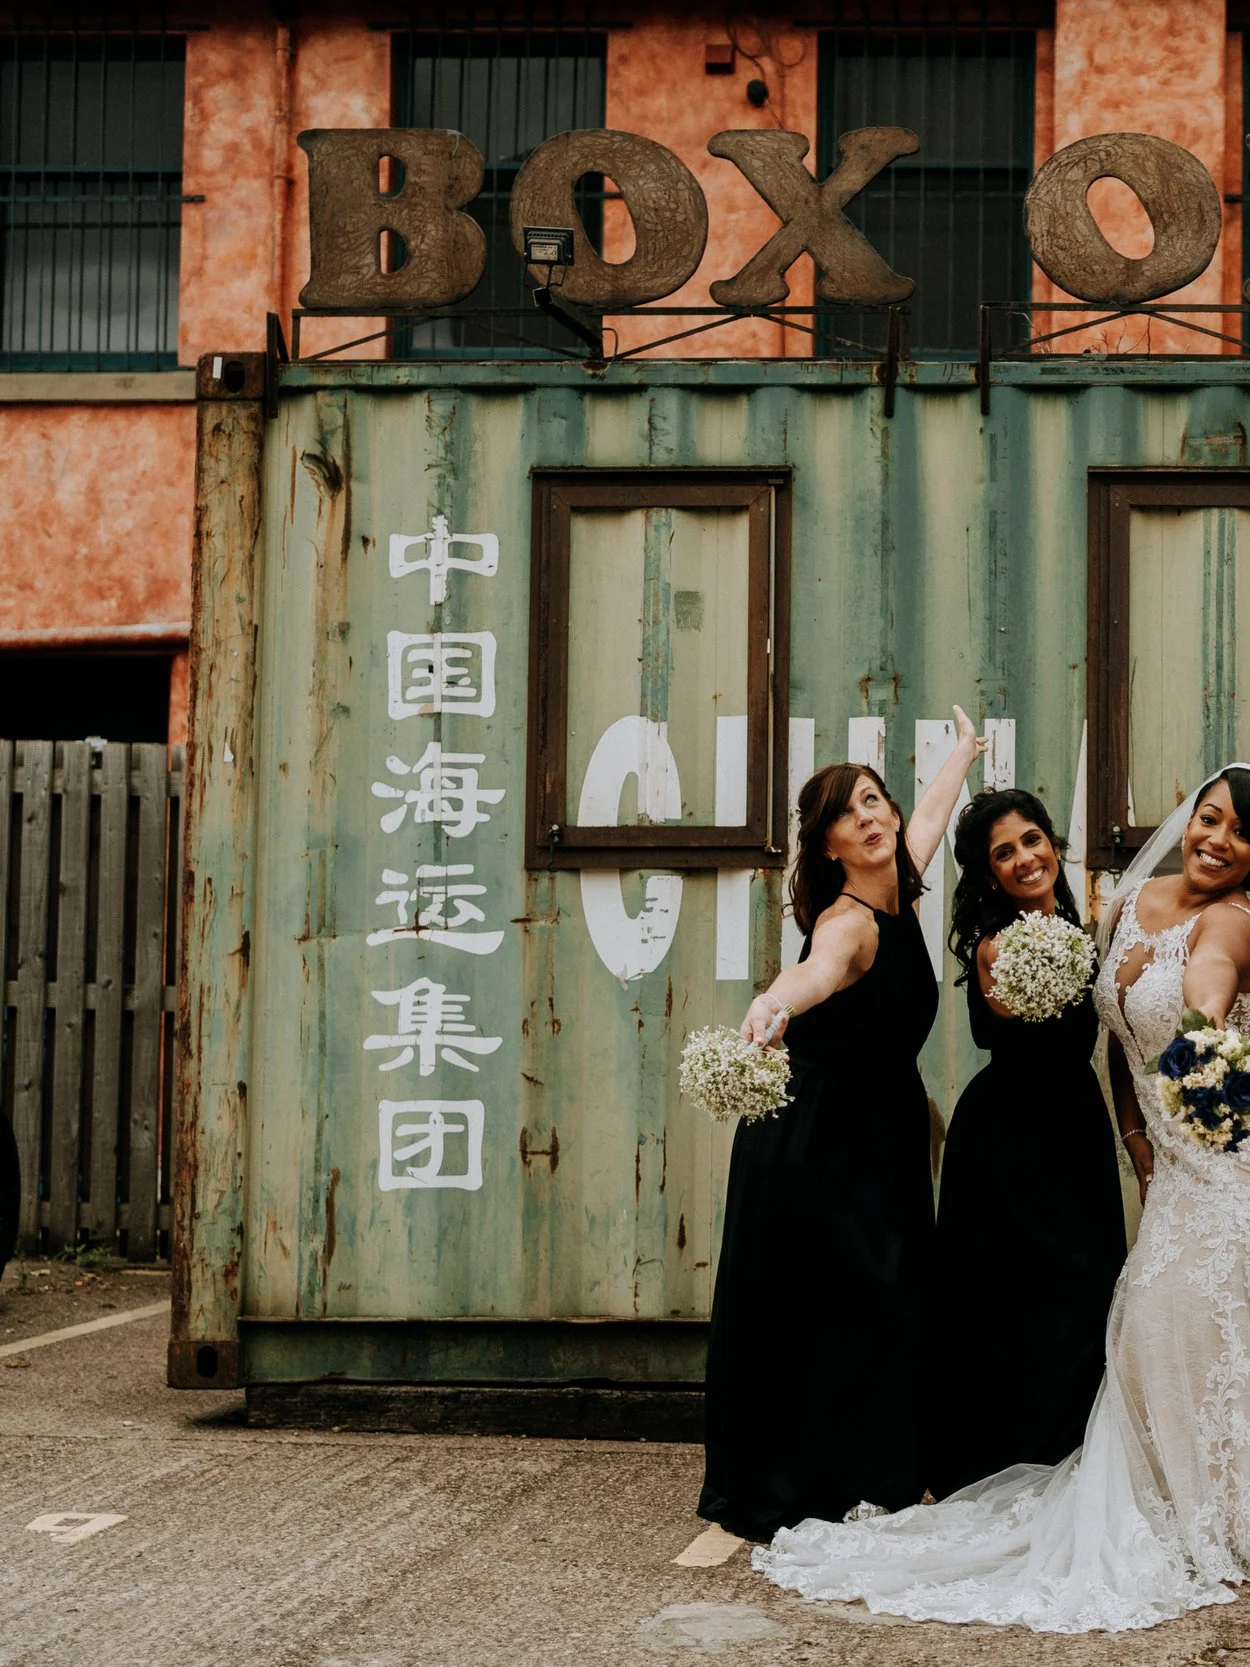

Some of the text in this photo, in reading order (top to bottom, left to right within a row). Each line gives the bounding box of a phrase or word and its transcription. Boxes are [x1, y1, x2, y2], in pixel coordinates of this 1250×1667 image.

[298, 127, 920, 308] BOX
[363, 515, 505, 1191] 中国海运集团
[578, 715, 1138, 985] CHN
